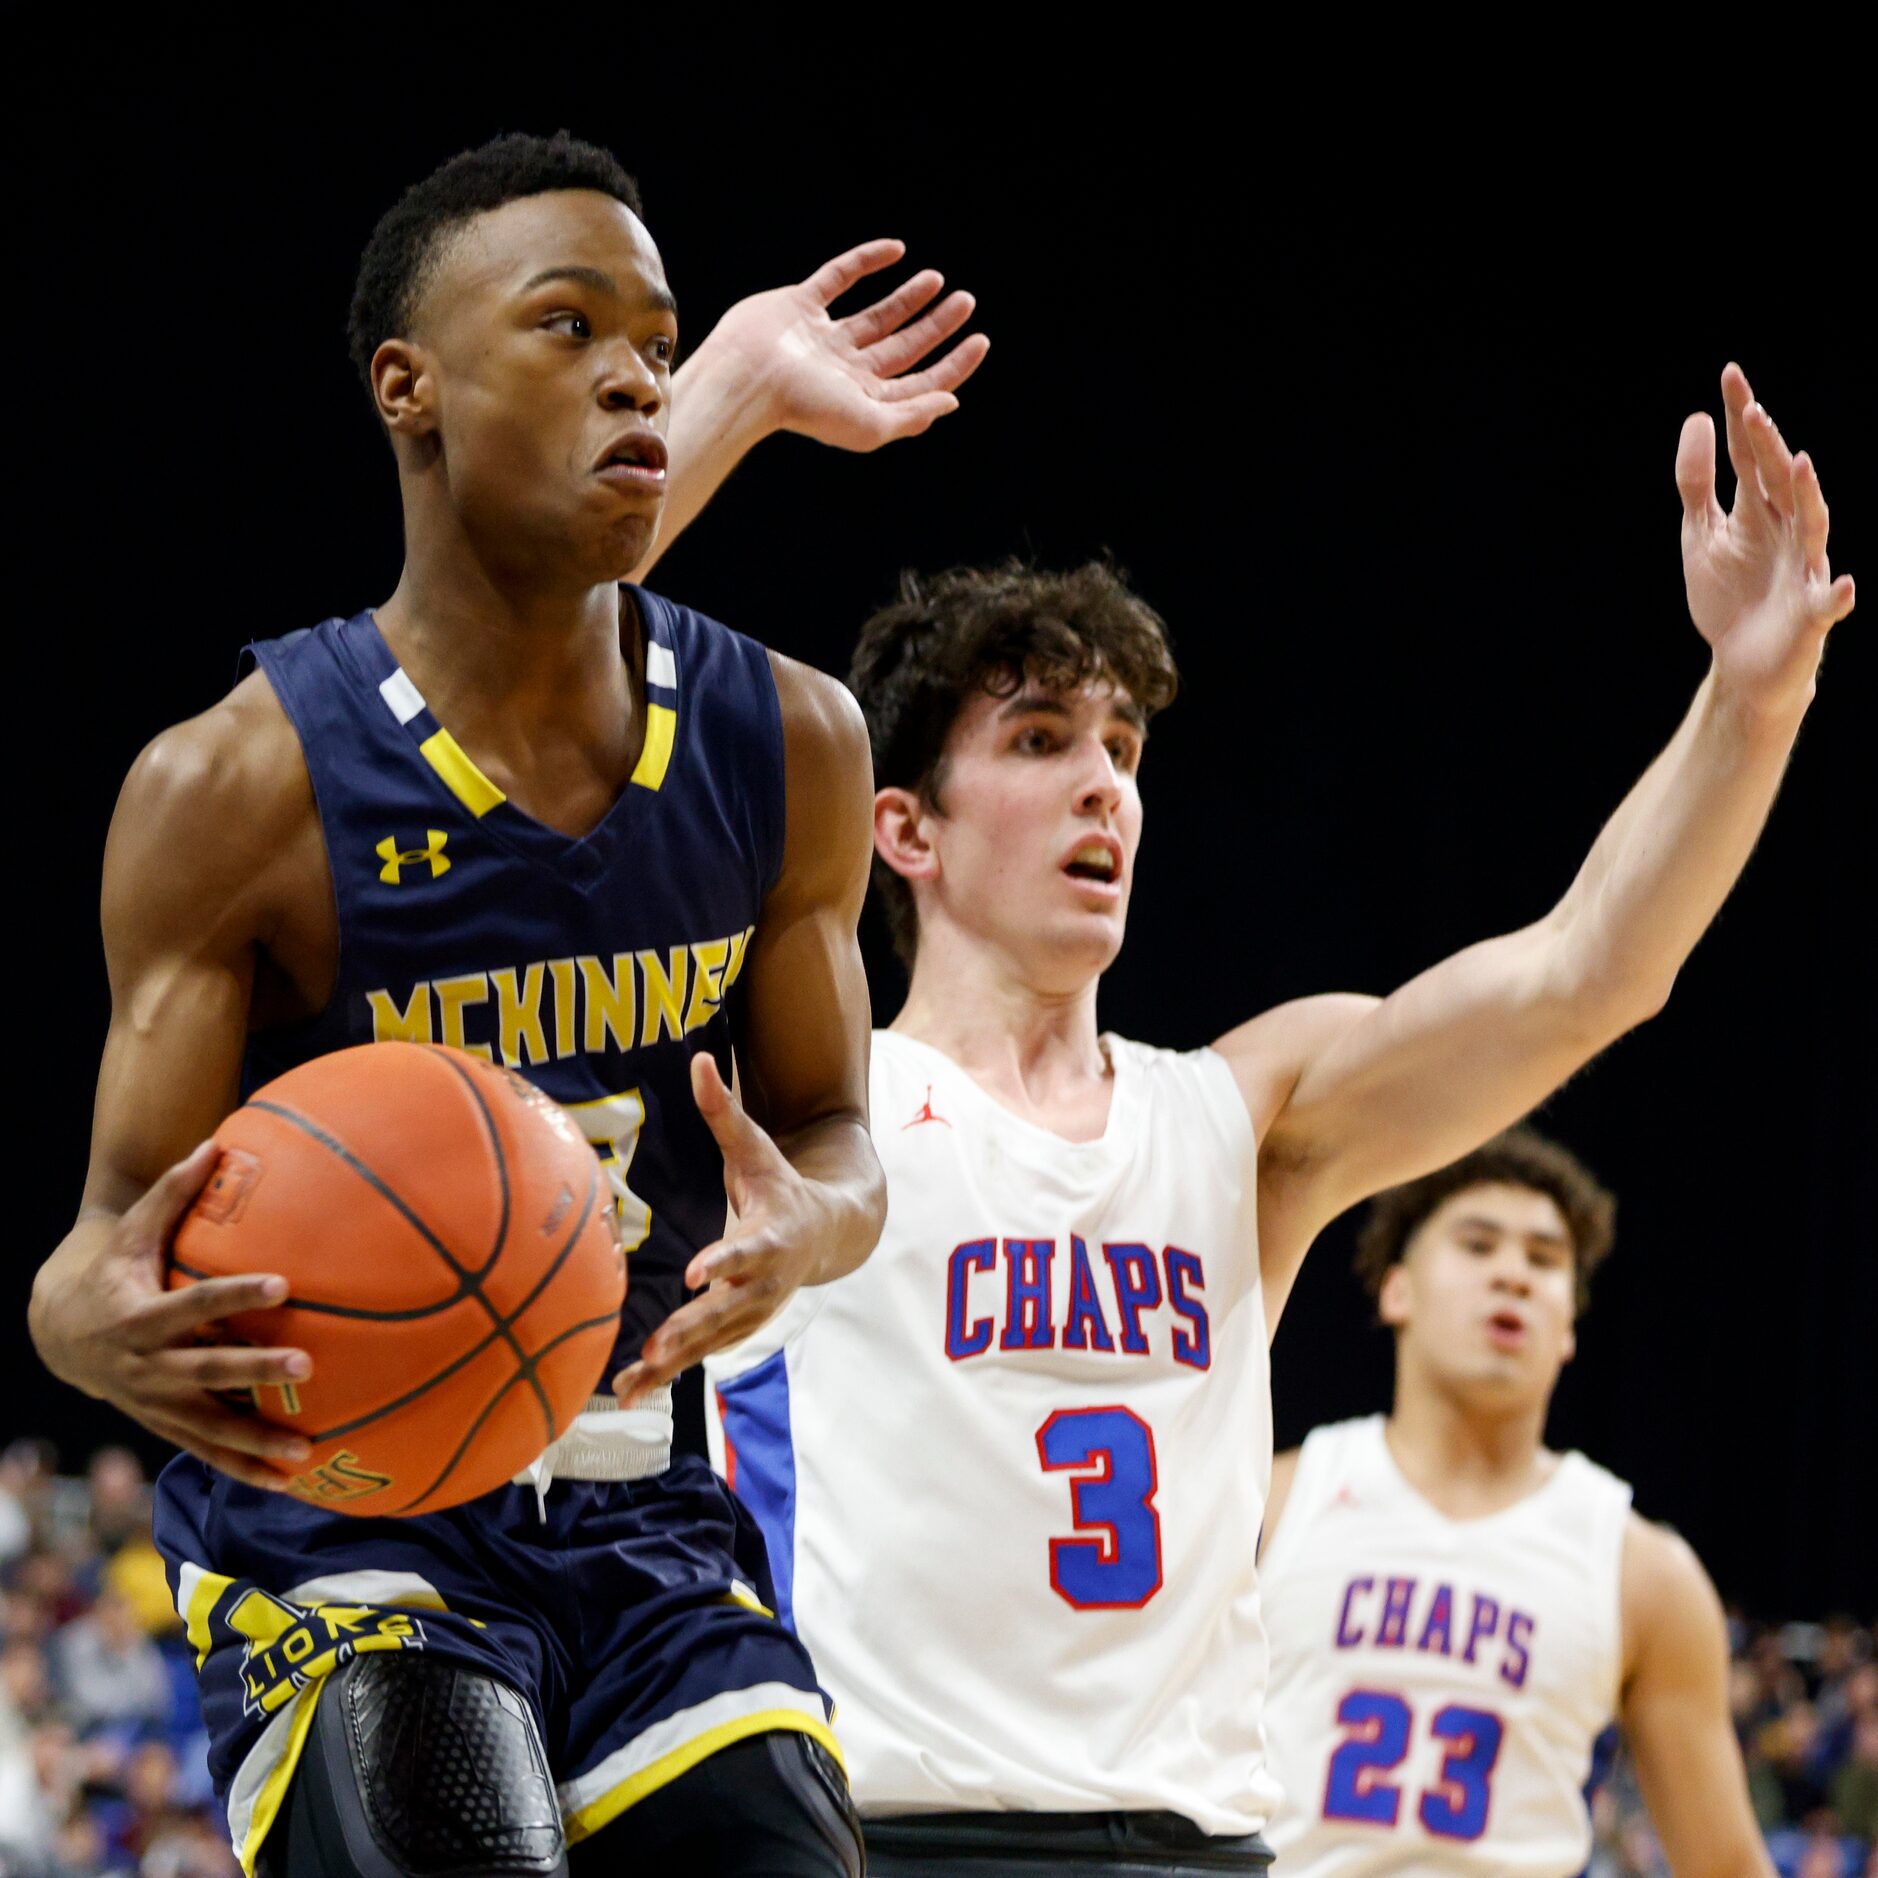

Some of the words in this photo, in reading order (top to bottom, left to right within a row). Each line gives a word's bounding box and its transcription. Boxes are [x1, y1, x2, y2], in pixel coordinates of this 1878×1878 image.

[945, 1233, 1211, 1371] CHAPS
[1034, 1404, 1163, 1611] 3
[1334, 1575, 1536, 1690] CHAPS
[1321, 1687, 1506, 1842] 23
